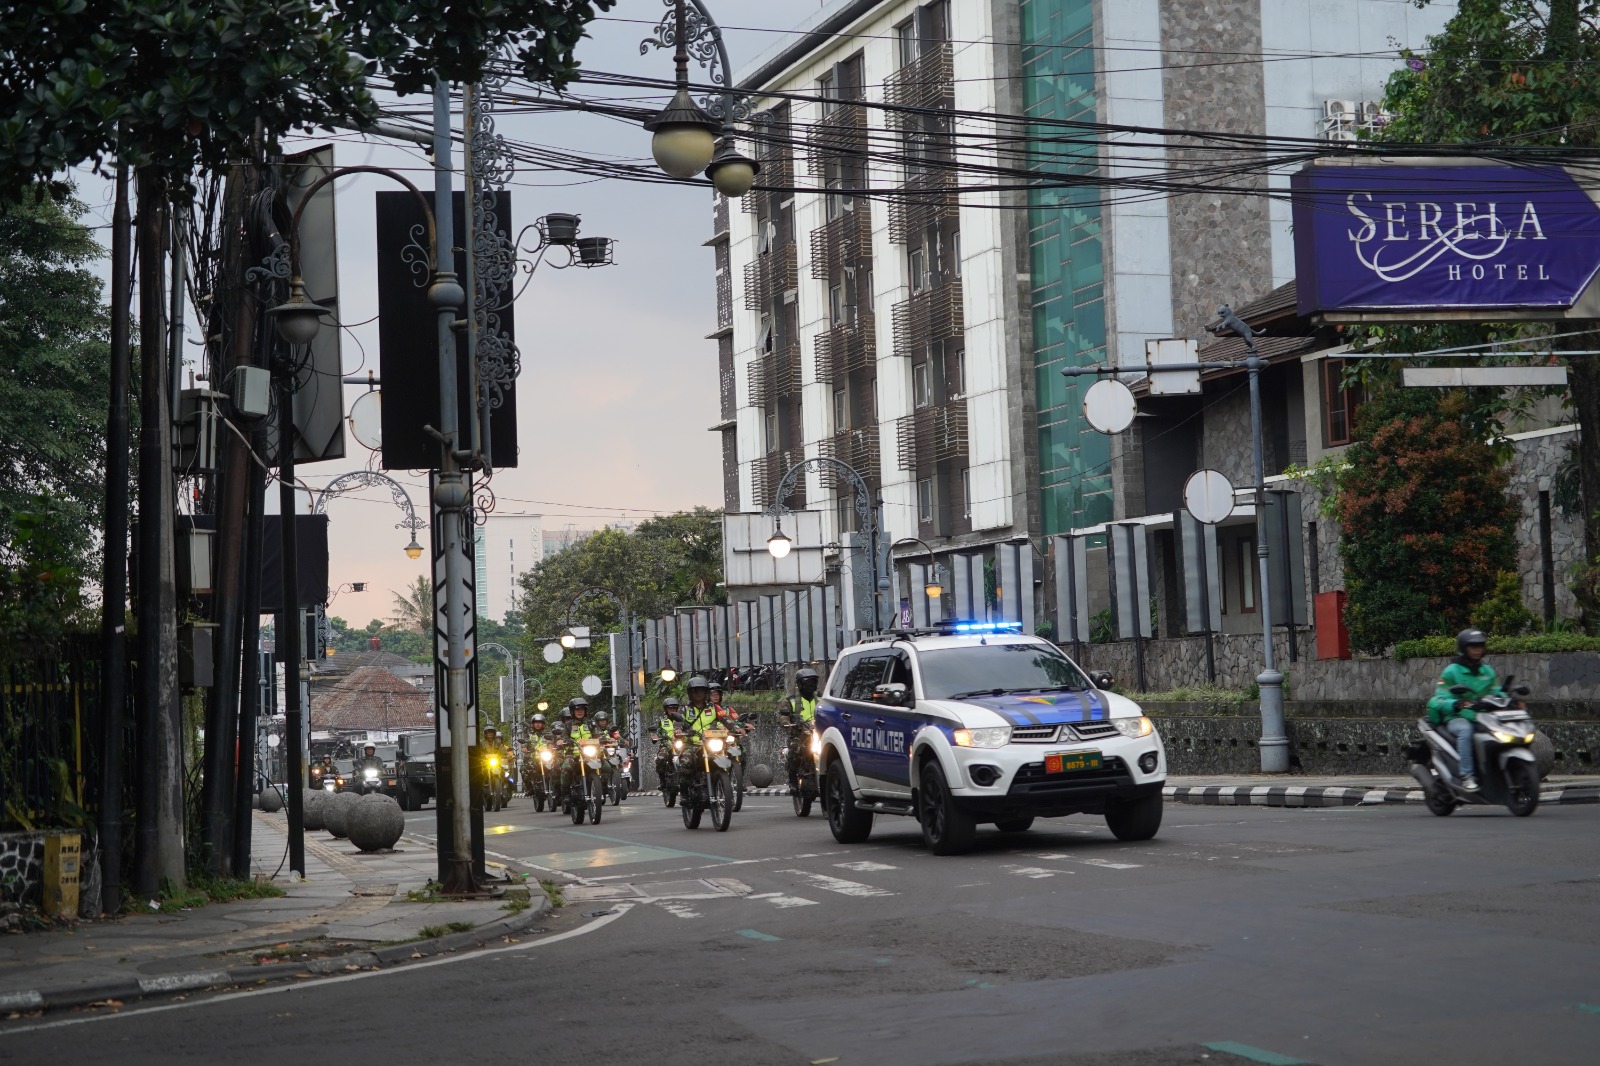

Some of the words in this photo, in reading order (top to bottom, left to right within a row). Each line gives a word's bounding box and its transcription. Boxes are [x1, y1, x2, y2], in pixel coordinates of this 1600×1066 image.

[1346, 191, 1548, 243] SERELA
[1448, 264, 1550, 281] HOTEL
[851, 726, 873, 749] POLISI
[875, 729, 905, 753] MILITER
